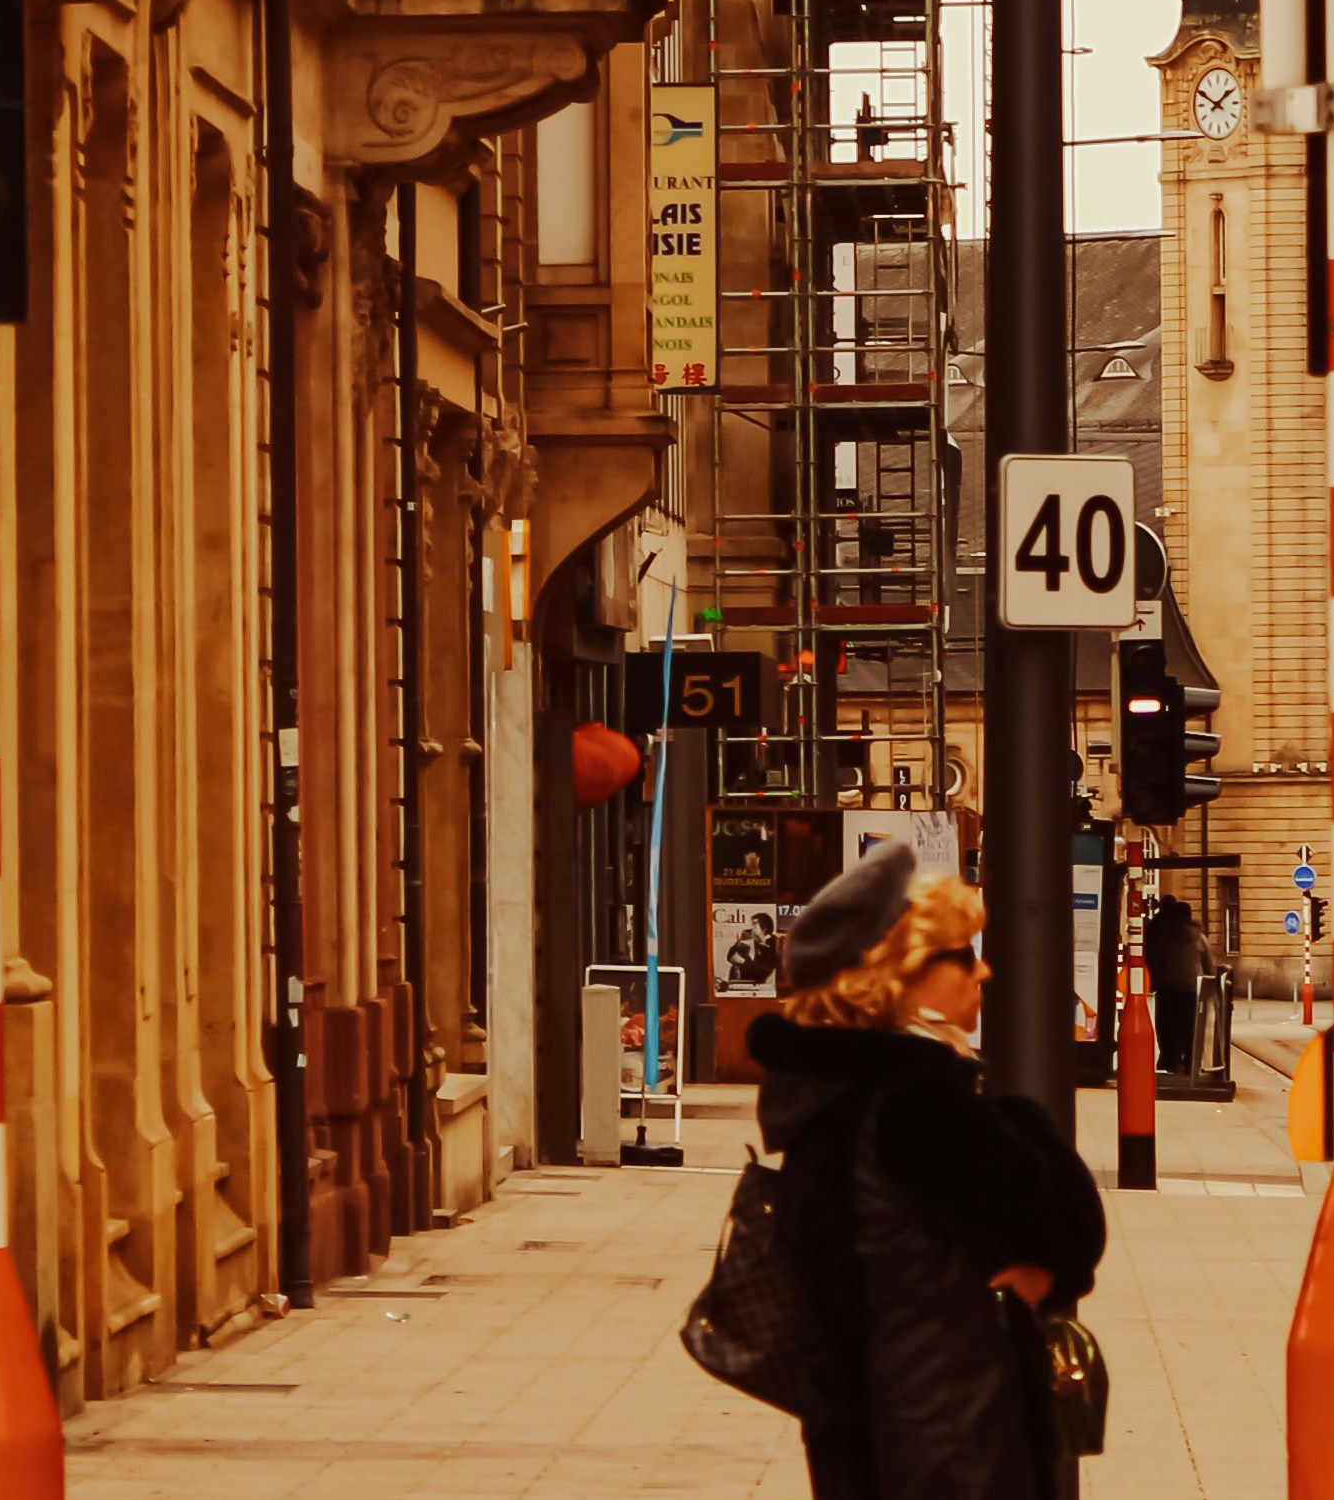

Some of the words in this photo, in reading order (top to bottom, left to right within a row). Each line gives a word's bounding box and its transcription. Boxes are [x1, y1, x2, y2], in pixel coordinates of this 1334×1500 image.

[1015, 494, 1126, 594] 40
[682, 675, 741, 717] 51
[713, 908, 746, 924] Cali
